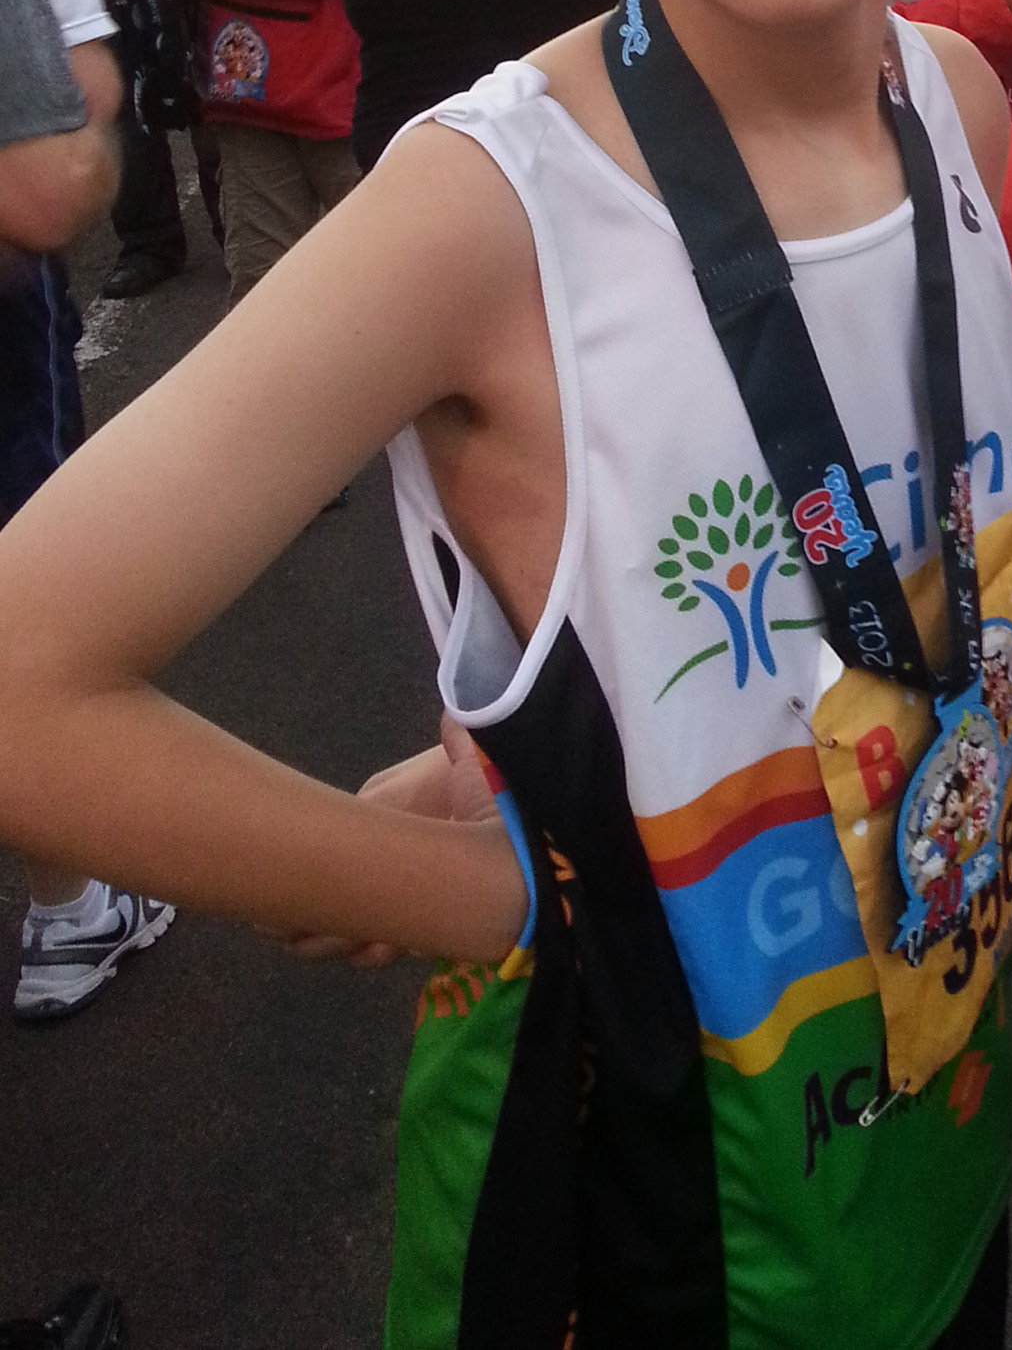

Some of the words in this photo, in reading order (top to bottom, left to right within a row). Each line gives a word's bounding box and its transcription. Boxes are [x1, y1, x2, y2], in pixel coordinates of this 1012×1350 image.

[793, 488, 848, 565] 20
[823, 463, 878, 568] Years
[849, 600, 894, 668] 2013
[855, 725, 906, 812] B
